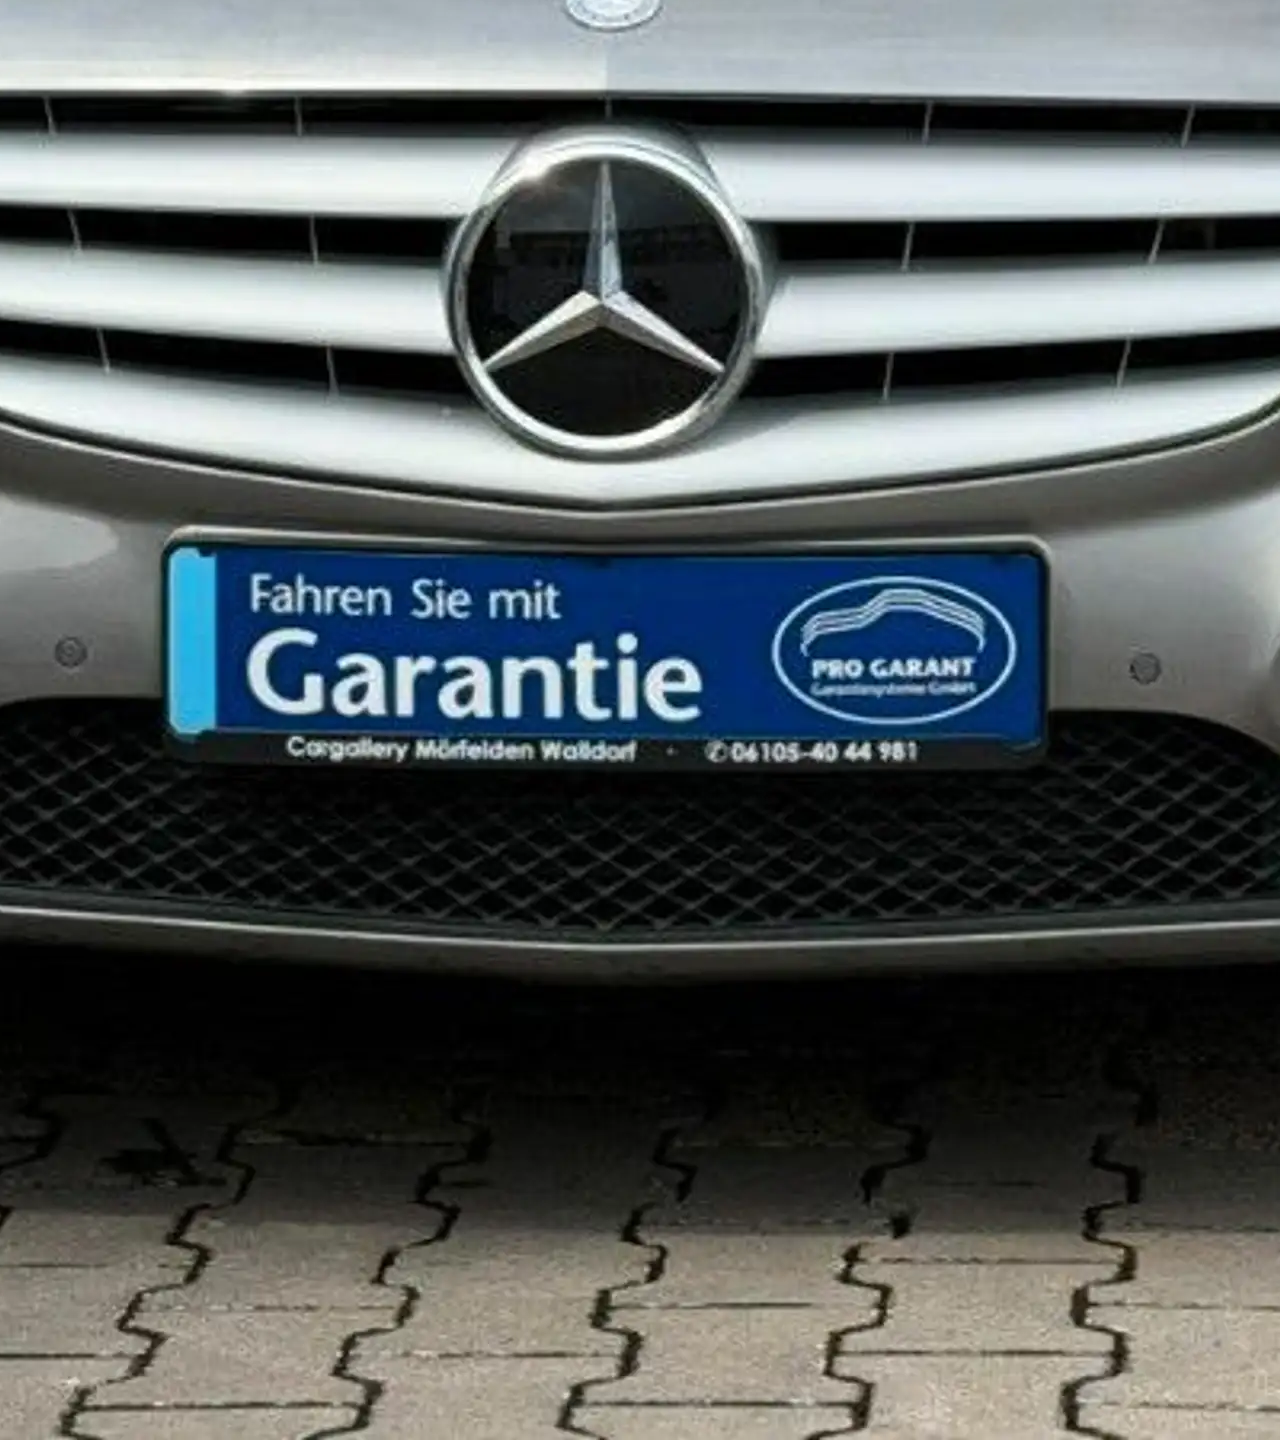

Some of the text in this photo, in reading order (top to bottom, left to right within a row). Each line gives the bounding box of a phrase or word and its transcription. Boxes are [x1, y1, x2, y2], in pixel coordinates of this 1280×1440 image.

[250, 573, 562, 620] Fahren Sie mit
[246, 626, 703, 722] Garantie
[812, 657, 976, 680] PRO GARANT
[286, 735, 918, 763] Cargallery Mörfelden Walldorf 06105-40 44 981
